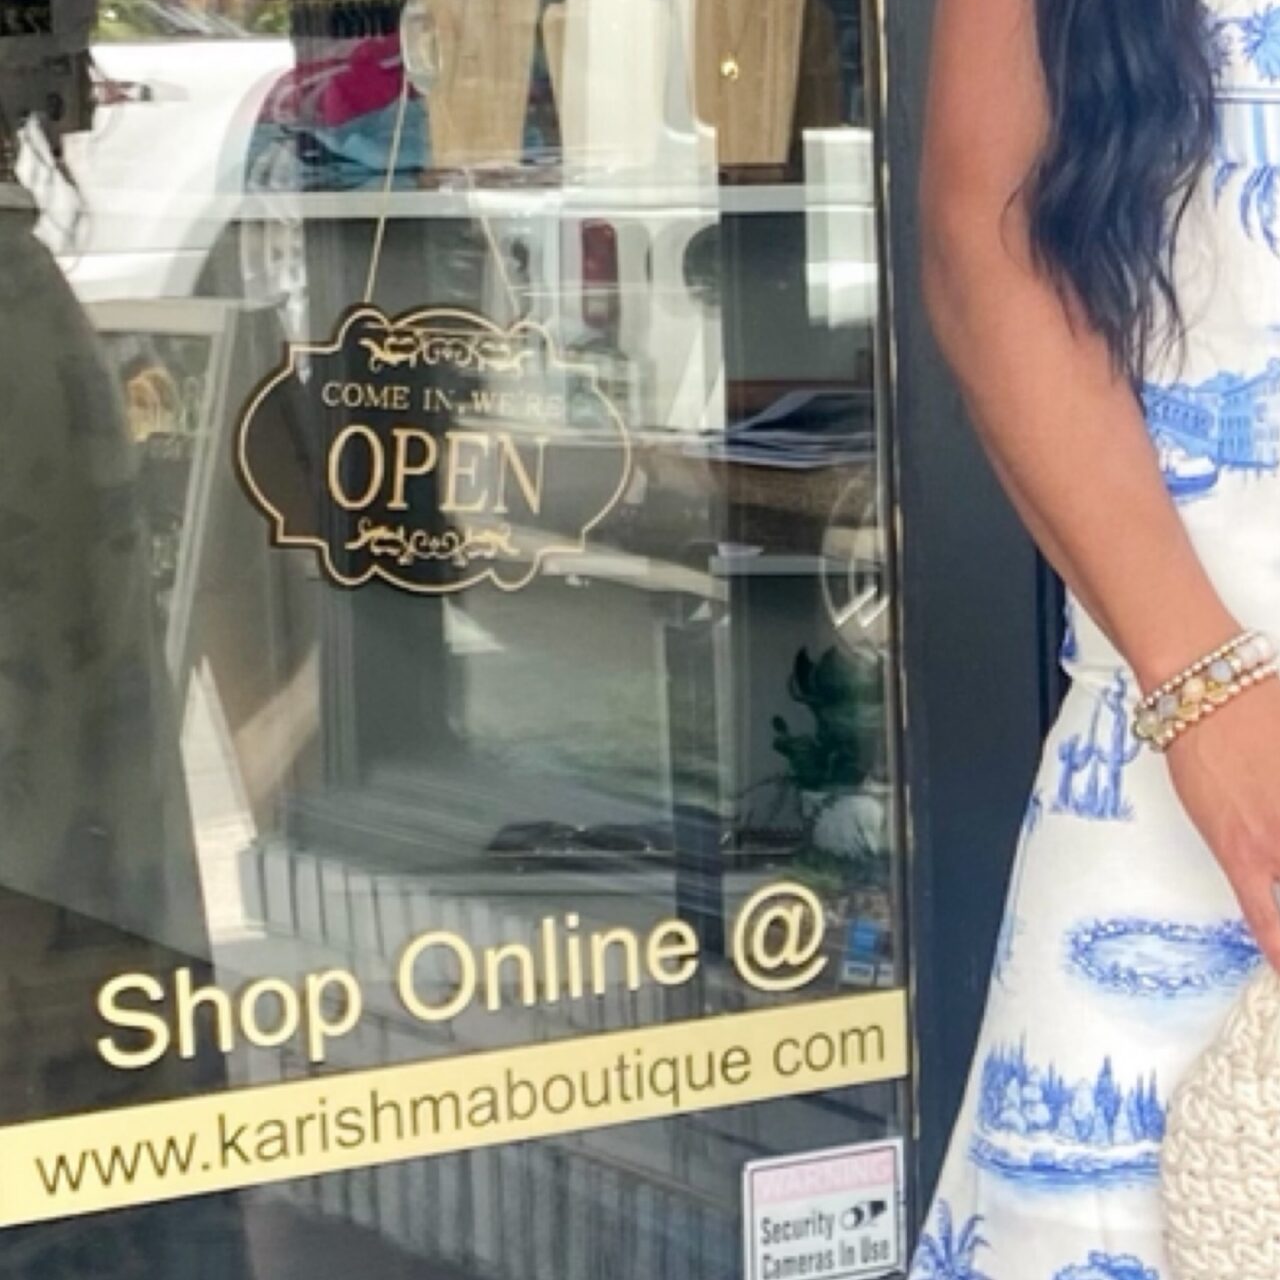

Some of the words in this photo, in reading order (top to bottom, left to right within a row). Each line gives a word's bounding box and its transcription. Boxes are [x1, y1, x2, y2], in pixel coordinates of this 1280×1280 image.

[322, 382, 410, 410] COME
[328, 424, 548, 514] OPEN
[97, 966, 362, 1069] Shop
[398, 913, 699, 1022] Online
[733, 881, 829, 992] @
[755, 1154, 893, 1199] WARNING
[761, 1209, 835, 1246] Security
[761, 1248, 835, 1280] Cameras
[838, 1238, 855, 1267] In
[860, 1235, 889, 1264] Use
